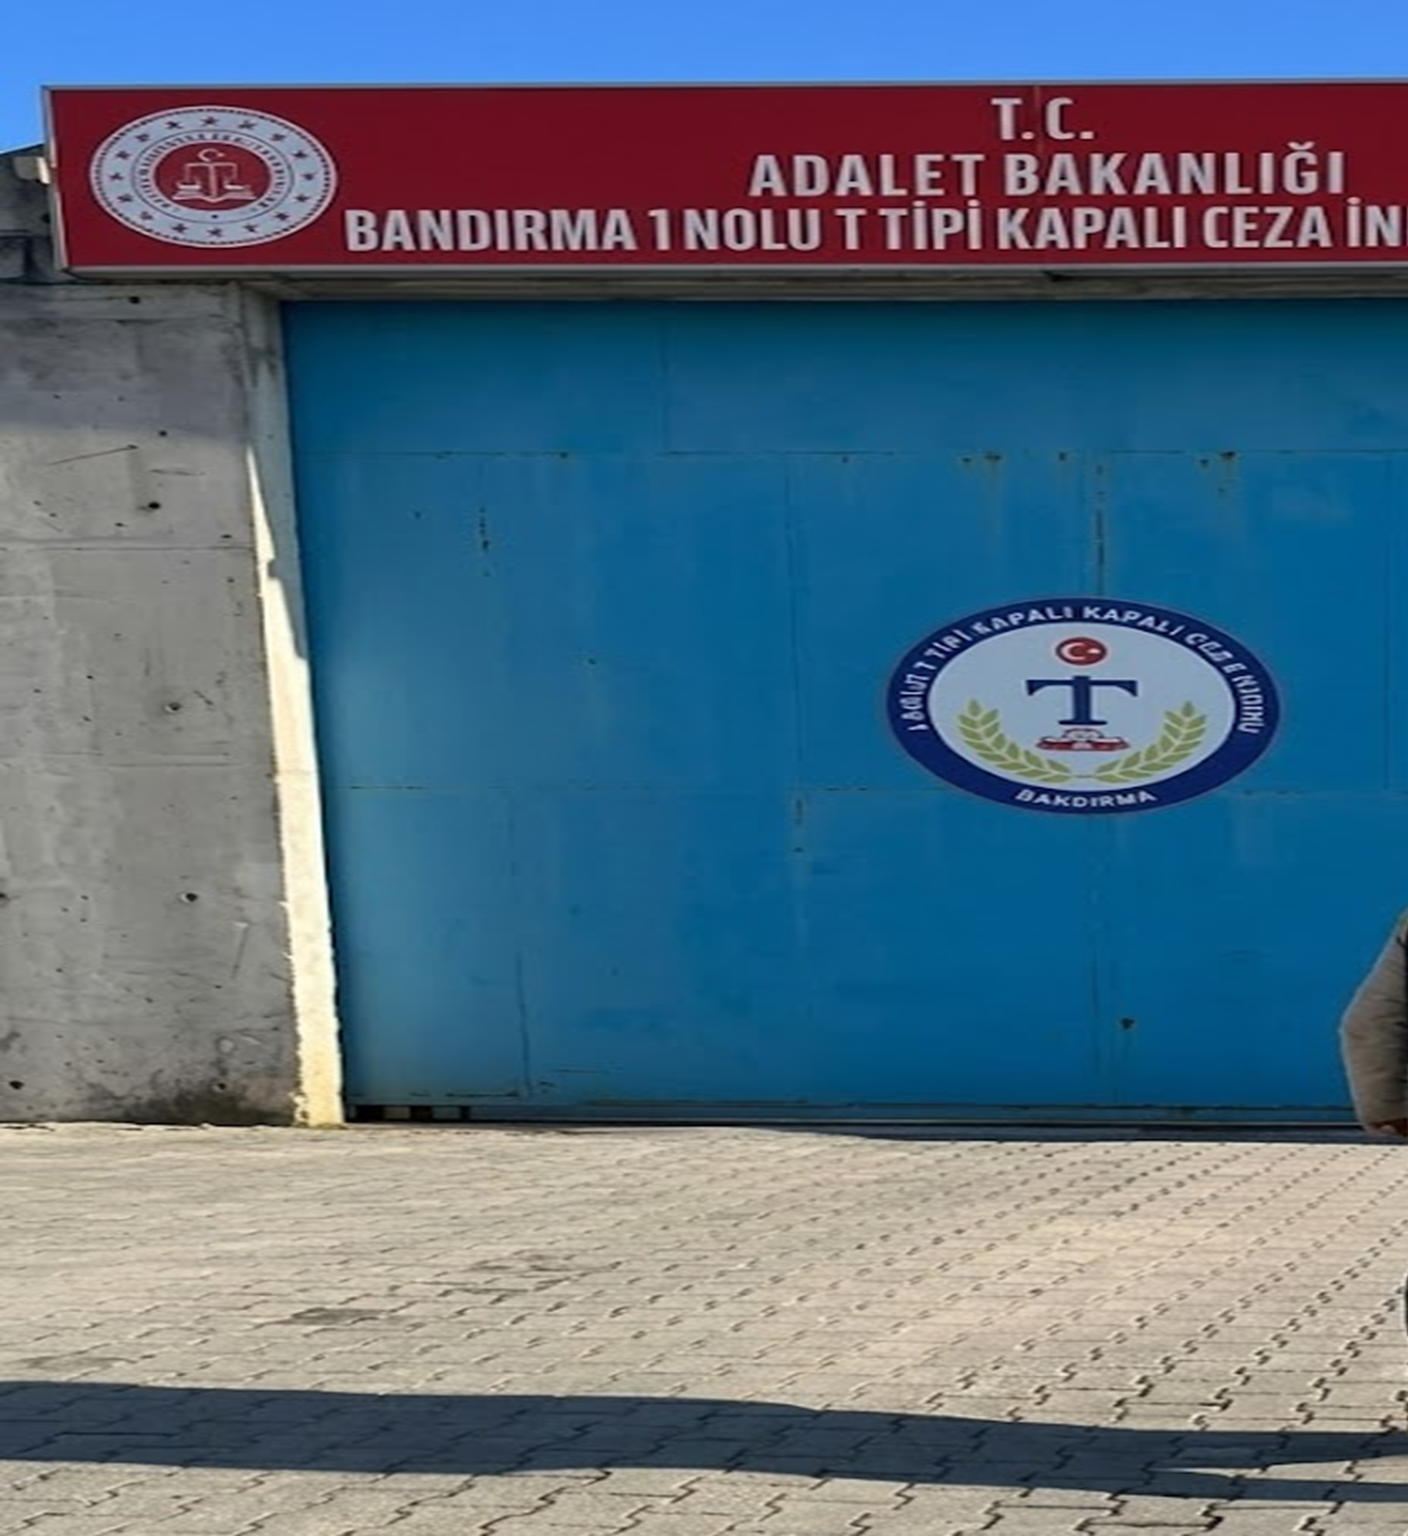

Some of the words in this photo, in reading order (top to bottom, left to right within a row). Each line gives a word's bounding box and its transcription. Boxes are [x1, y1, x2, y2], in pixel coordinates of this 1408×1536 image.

[750, 154, 984, 196] ADALET
[1005, 141, 1342, 196] BAKANLIĞI
[345, 209, 636, 251] BANDIRMA
[648, 209, 669, 250] 1
[685, 208, 820, 251] NOLU
[836, 208, 866, 250] T
[878, 199, 981, 250] TİPİ
[998, 206, 1185, 250] KAPALI
[1204, 206, 1331, 248] CEZA
[1025, 675, 1138, 726] T
